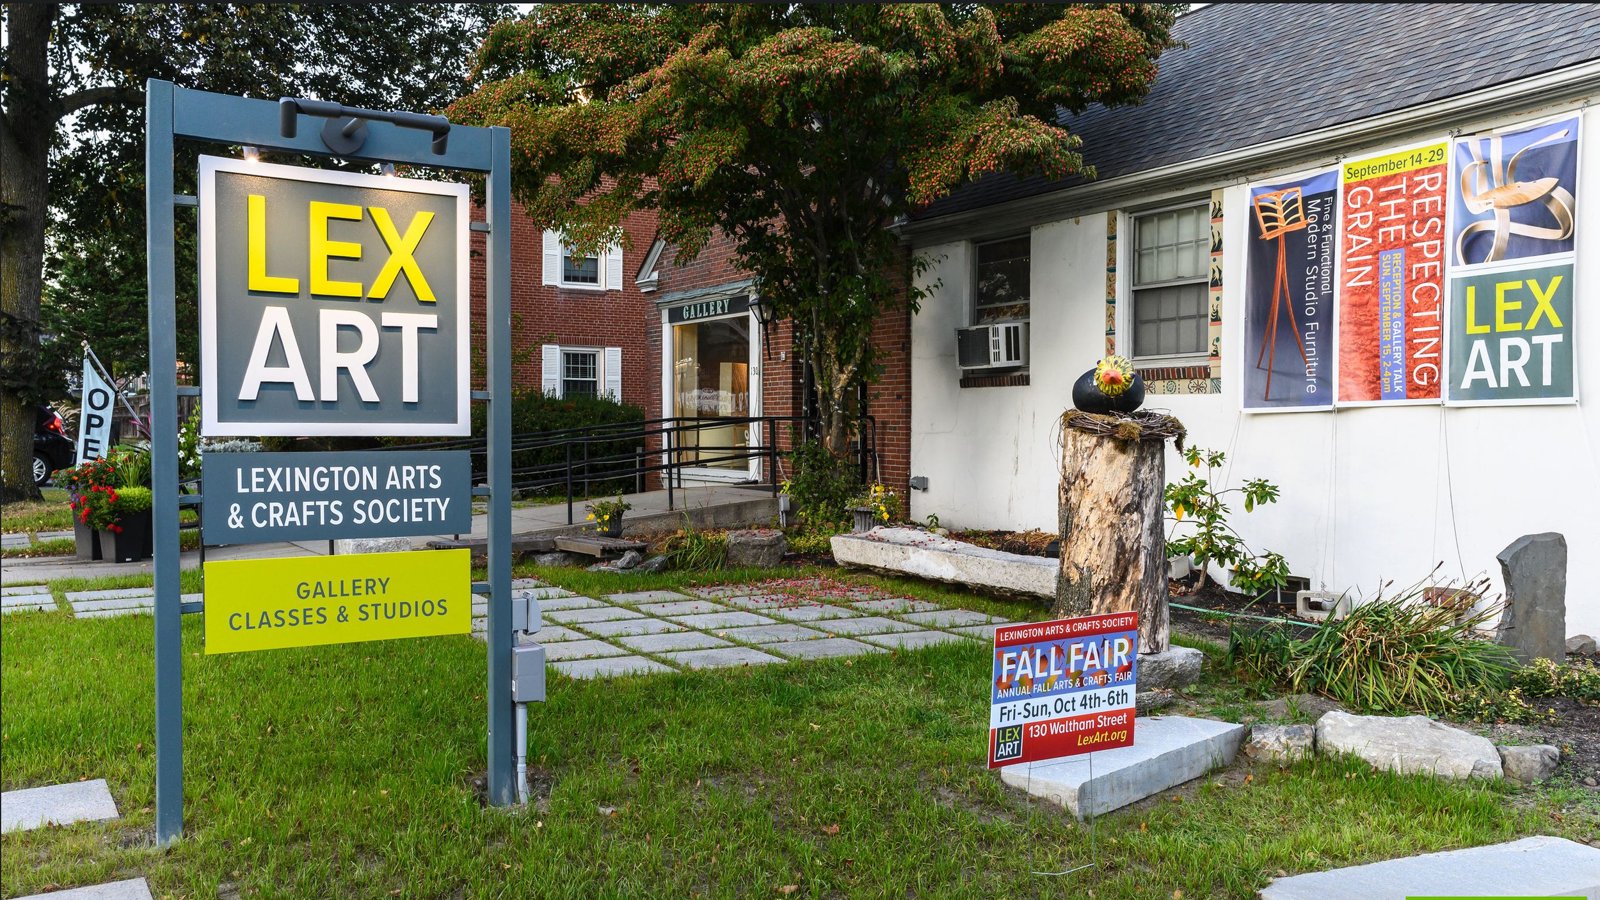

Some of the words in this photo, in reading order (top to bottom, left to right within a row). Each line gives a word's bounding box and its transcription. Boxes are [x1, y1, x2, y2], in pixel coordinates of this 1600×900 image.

[1346, 158, 1408, 180] September
[1322, 195, 1333, 221] Fine
[1378, 176, 1407, 244] THE
[1306, 199, 1321, 260] Modern
[1321, 223, 1332, 232] &
[1346, 186, 1374, 288] GRAIN
[248, 194, 437, 302] LEX
[1321, 234, 1333, 296] Functional
[1304, 265, 1319, 316] Studio
[1392, 252, 1402, 310] RECEPTION
[1412, 172, 1442, 386] RESPECTING
[683, 300, 730, 319] GALLERY
[1382, 281, 1391, 341] SEPTEMBER
[1392, 311, 1402, 319] &
[1466, 275, 1564, 335] LEX
[237, 306, 438, 403] ART
[1305, 321, 1319, 394] Furniture
[1392, 320, 1402, 366] GALLERY
[1460, 333, 1564, 390] ART
[1393, 367, 1403, 393] TALK
[82, 388, 110, 460] OPE
[236, 466, 377, 494] LEXINGTON
[385, 464, 443, 490] ARTS
[227, 502, 245, 530] &
[251, 500, 344, 529] CRAFTS
[352, 497, 451, 525] SOCIETY
[296, 577, 391, 600] GALLERY
[228, 606, 328, 631] CLASSES
[336, 605, 349, 623] &
[358, 598, 448, 622] STUDIOS
[1000, 628, 1044, 642] LEXINGTON
[1045, 624, 1064, 636] ARTS
[1065, 623, 1071, 633] &
[1072, 619, 1101, 632] CRAFTS
[1102, 616, 1134, 629] SOCIETY
[1001, 646, 1063, 683] FALL
[1069, 637, 1130, 673] FAIR
[997, 686, 1031, 700] ANNUAL
[1032, 682, 1051, 694] FALL
[1053, 679, 1073, 691] ARTS
[1075, 677, 1081, 688] &
[1082, 674, 1112, 687] CRAFTS
[1114, 671, 1132, 683] FAIR
[999, 702, 1051, 723] Fri-Sun,
[1054, 697, 1076, 714] Oct
[1079, 689, 1128, 710] 4th-6th
[999, 727, 1020, 743] LEX
[1028, 723, 1047, 738] 130
[1050, 718, 1095, 735] Waltham
[1097, 712, 1127, 728] Street
[1077, 729, 1127, 747] LexArt.org
[997, 741, 1020, 757] ART
